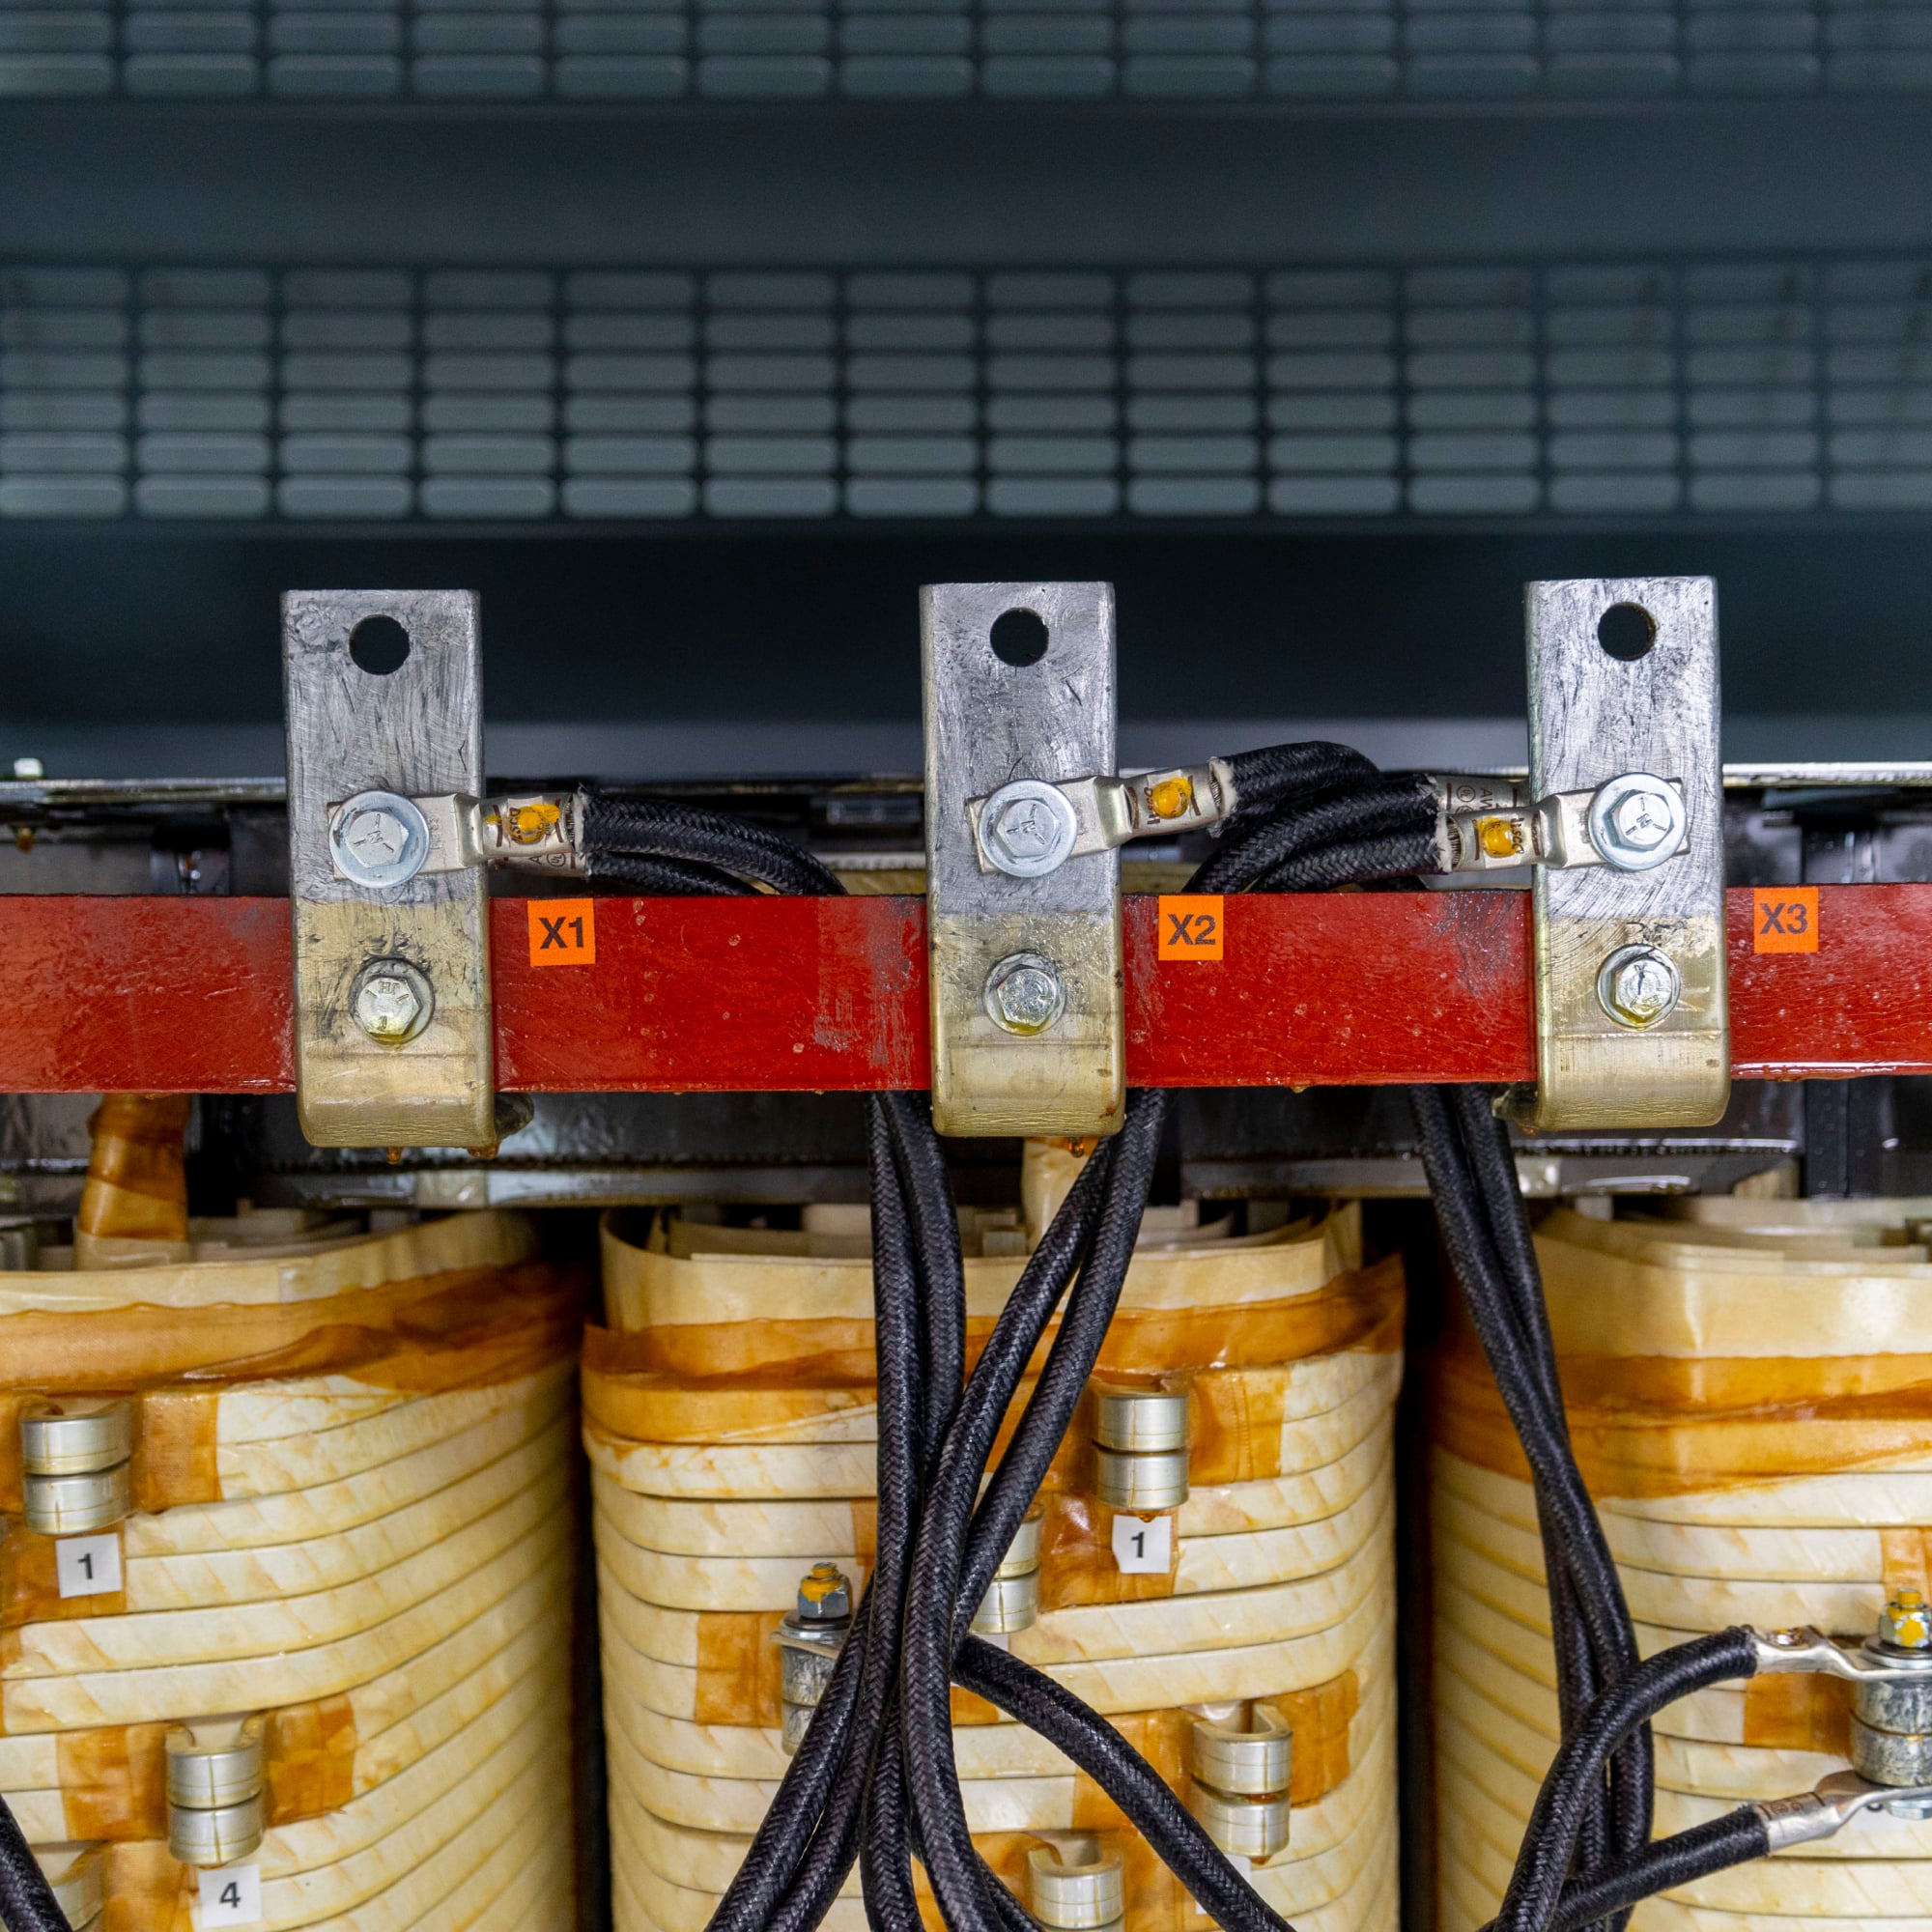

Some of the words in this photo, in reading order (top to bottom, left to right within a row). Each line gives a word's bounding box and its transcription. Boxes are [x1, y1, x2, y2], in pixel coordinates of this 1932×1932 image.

[538, 916, 584, 950] X1
[1167, 913, 1216, 946] X2
[1759, 902, 1808, 935] X3
[1130, 1530, 1146, 1559] 1
[76, 1551, 94, 1580] 1
[218, 1881, 242, 1909] 4
